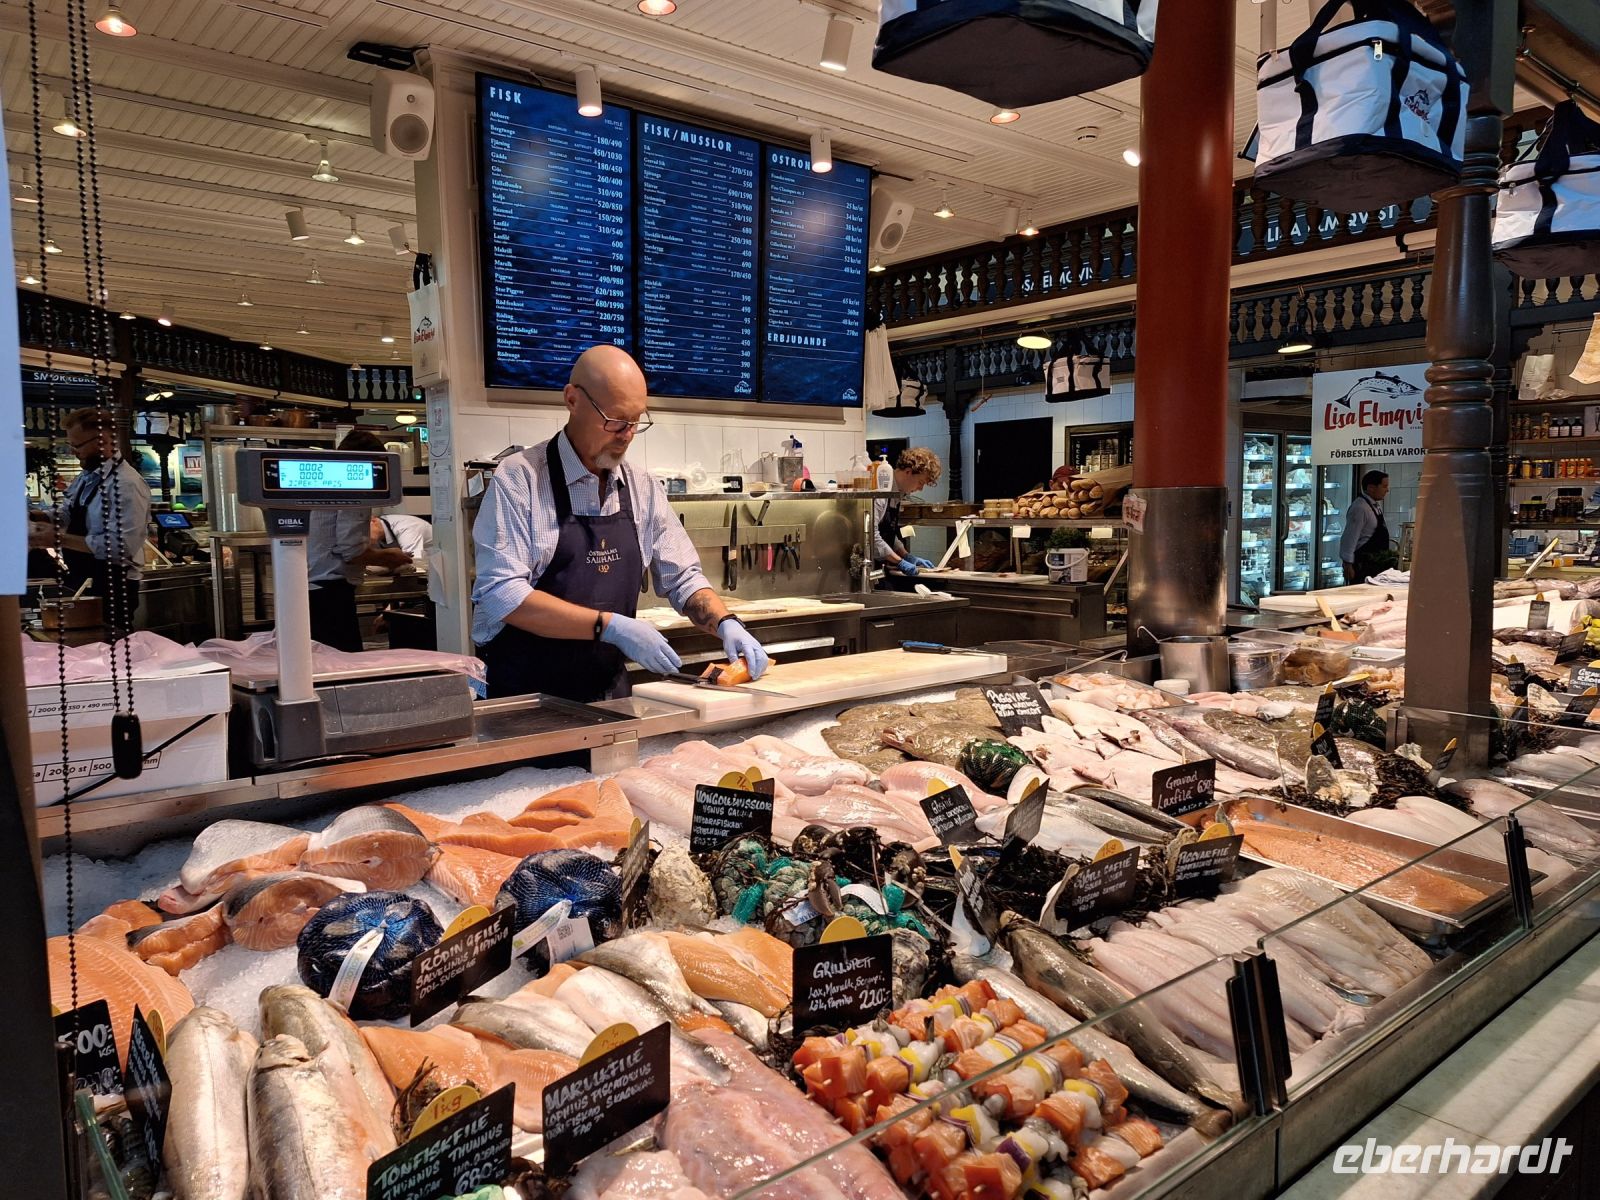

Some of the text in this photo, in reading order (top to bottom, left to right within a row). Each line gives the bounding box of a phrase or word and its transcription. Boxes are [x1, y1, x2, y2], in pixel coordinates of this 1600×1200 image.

[490, 86, 522, 104] FISK
[597, 136, 623, 148] 180/490
[597, 175, 623, 186] 260/400
[597, 188, 623, 199] 310/690
[597, 200, 623, 211] 520/850
[598, 213, 623, 224] 150/290
[611, 240, 624, 249] 600
[612, 253, 624, 261] 750
[598, 276, 624, 286] 490/980
[767, 333, 827, 347] ERBJUDANDE
[1324, 403, 1357, 430] Lisa
[1352, 436, 1403, 447] UTLÄMNING
[1330, 447, 1426, 459] FÖRBESTÄLLDA VAROR
[986, 689, 1031, 704] PIGGVAR
[78, 765, 87, 773] st
[92, 762, 112, 771] 500
[1165, 770, 1198, 790] Gravad
[1157, 786, 1194, 810] Laxfilé
[812, 956, 876, 979] GRILLSPETT
[545, 1041, 644, 1114] MARULKFILÉ
[545, 1095, 589, 1128] LOPHIUS
[373, 1106, 490, 1190] TONFISKFILÉ
[448, 1123, 503, 1163] THUNNUS
